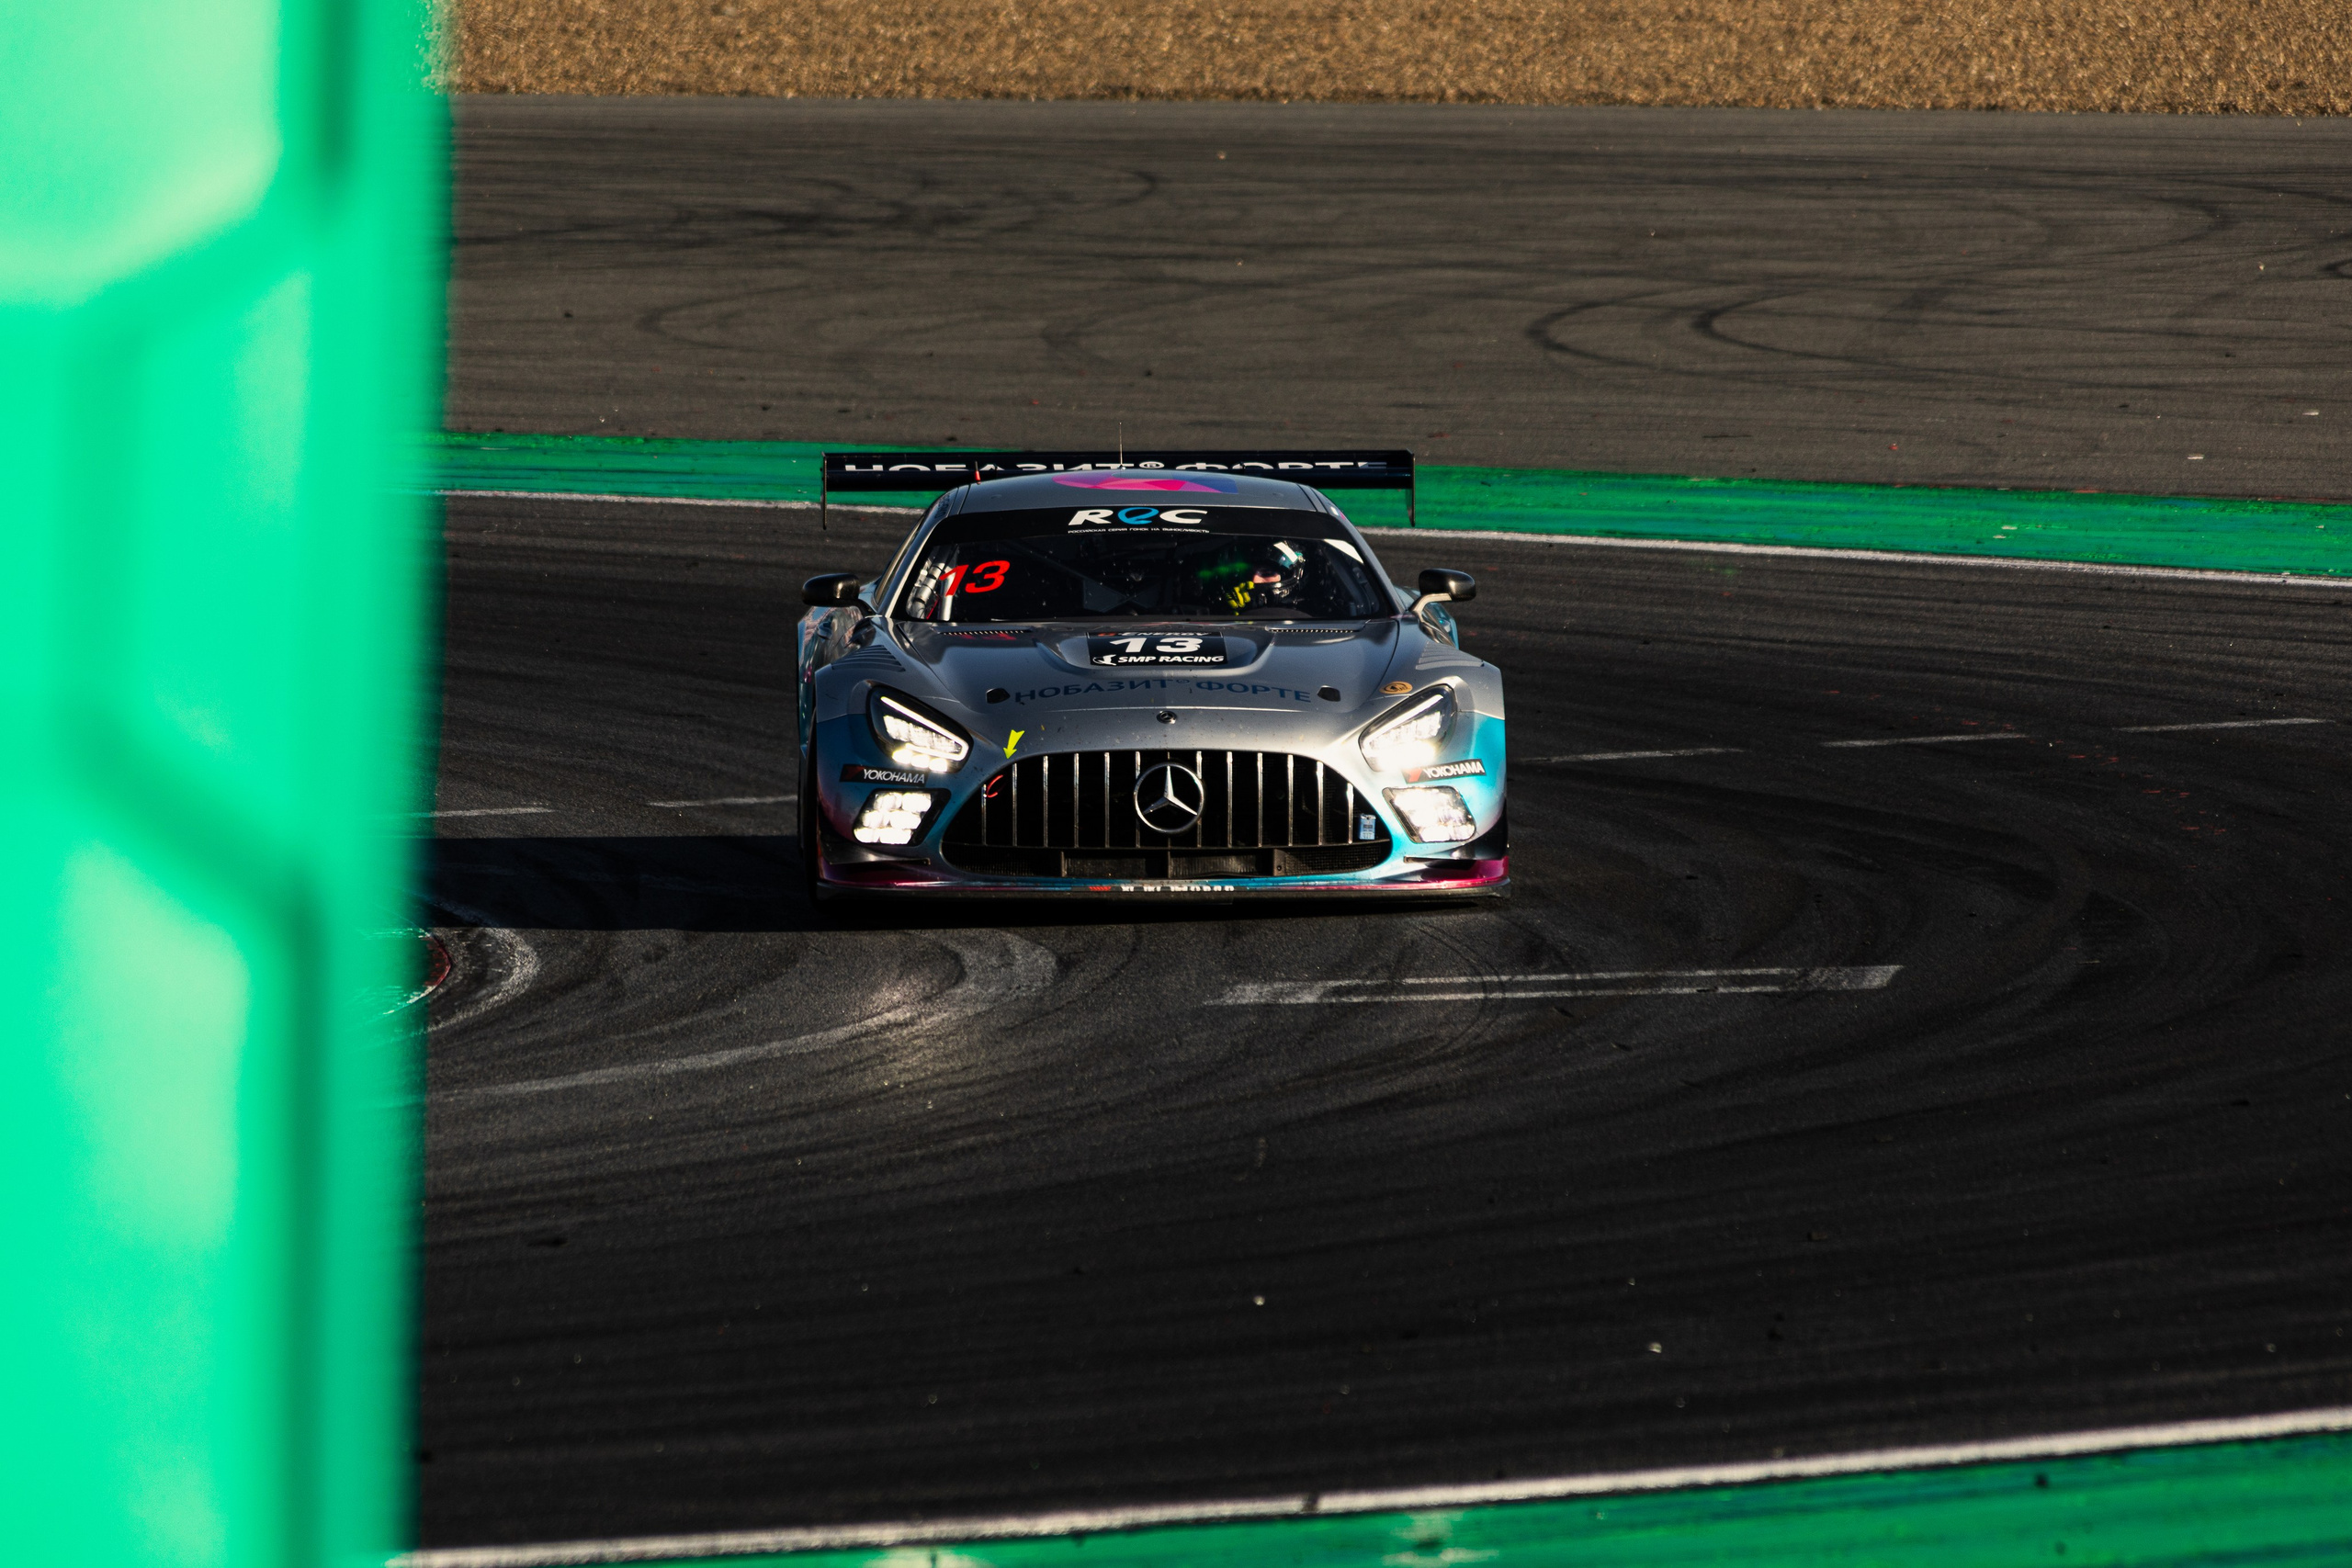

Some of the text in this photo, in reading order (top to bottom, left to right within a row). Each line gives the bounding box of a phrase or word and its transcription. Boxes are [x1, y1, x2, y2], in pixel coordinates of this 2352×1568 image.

[939, 559, 1011, 597] 13
[1109, 637, 1204, 653] 13
[1117, 655, 1157, 663] SMP
[1196, 681, 1311, 703] ФОРТЕ
[863, 768, 925, 784] YOKOHAMA
[1422, 761, 1486, 778] YOKOHAMA
